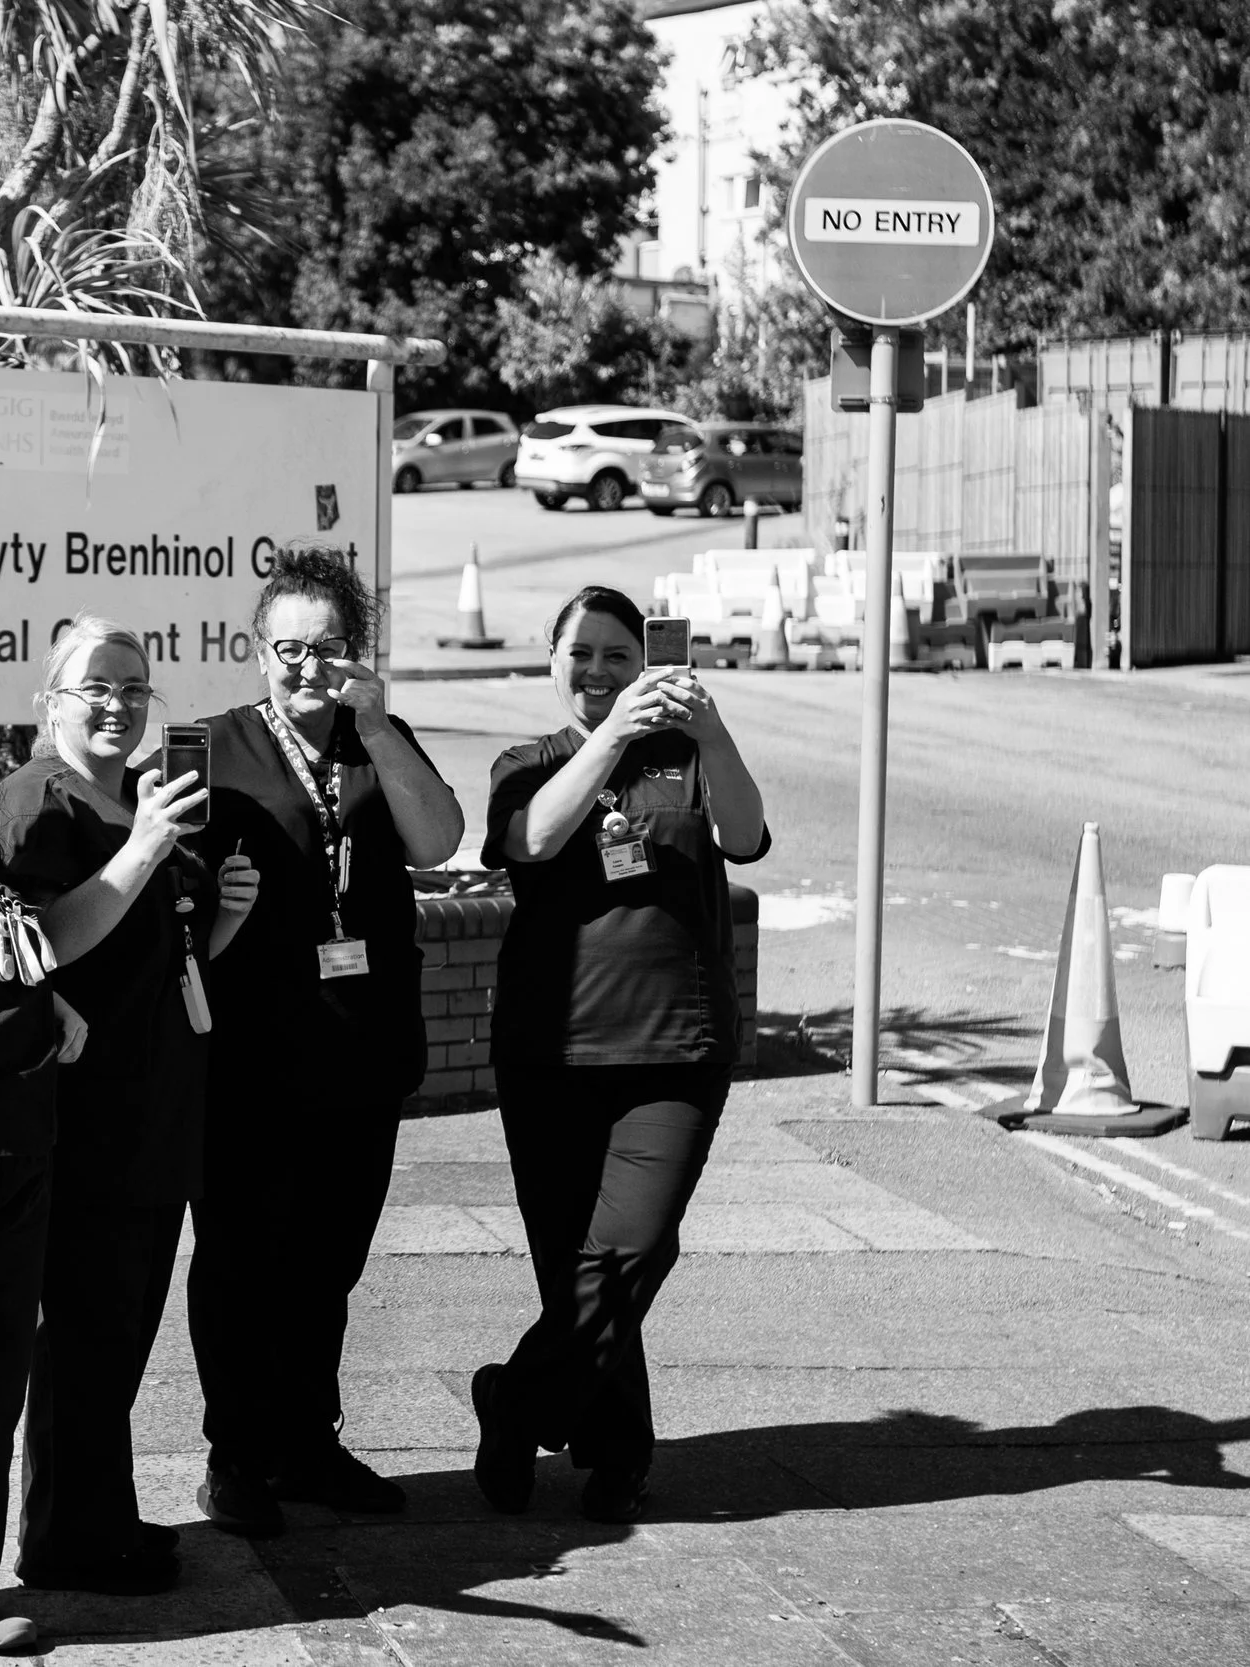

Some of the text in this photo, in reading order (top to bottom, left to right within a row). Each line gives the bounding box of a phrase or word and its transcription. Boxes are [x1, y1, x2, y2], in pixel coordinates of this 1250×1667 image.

[822, 209, 961, 234] NO ENTRY
[66, 531, 234, 578] Brenhinol
